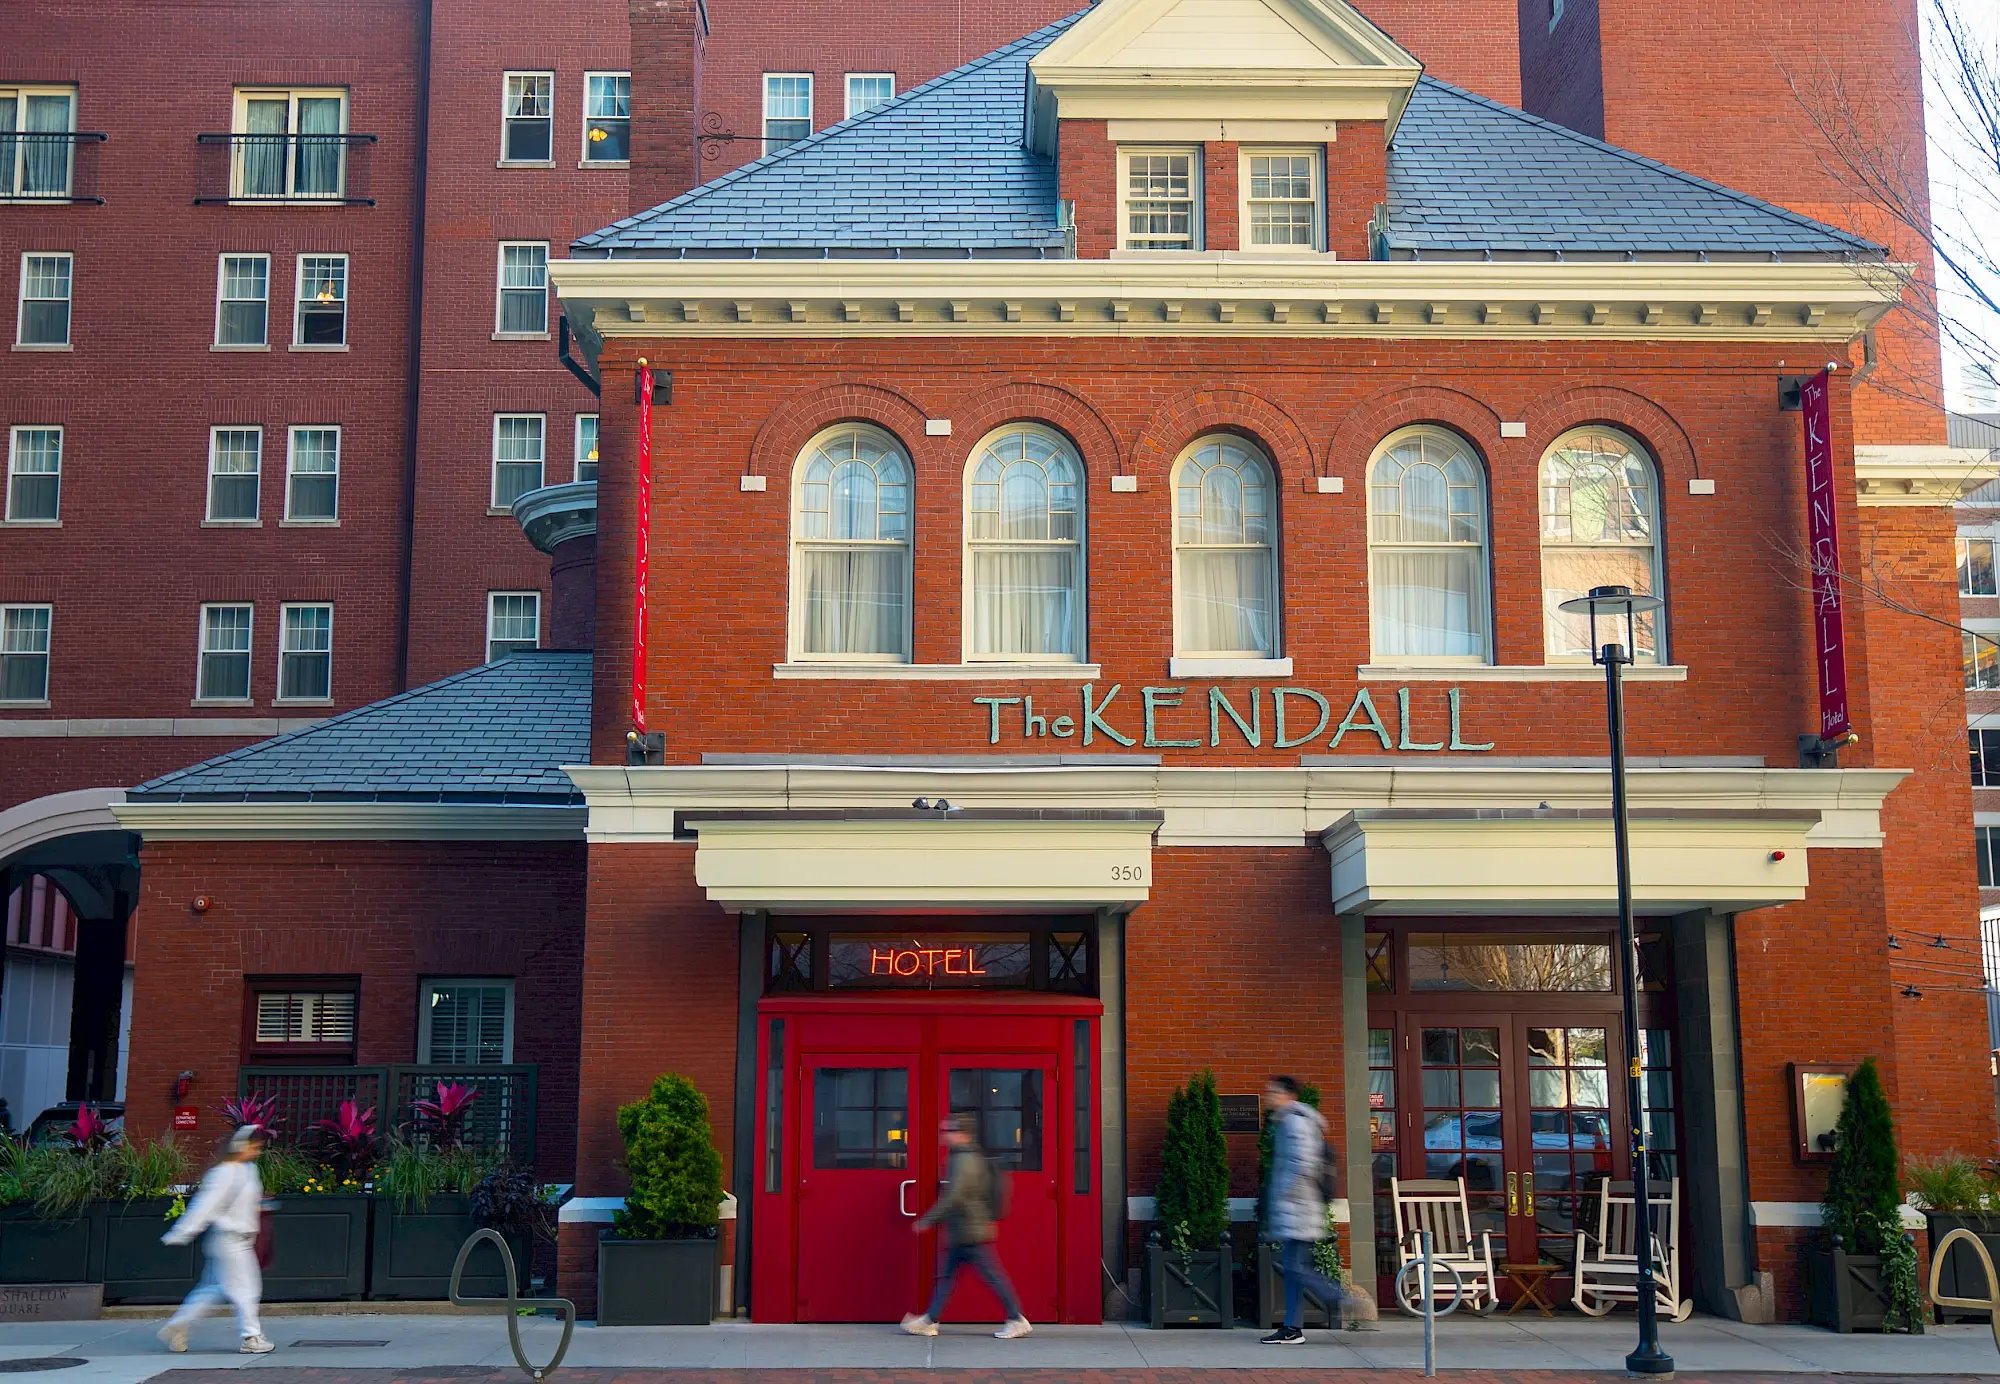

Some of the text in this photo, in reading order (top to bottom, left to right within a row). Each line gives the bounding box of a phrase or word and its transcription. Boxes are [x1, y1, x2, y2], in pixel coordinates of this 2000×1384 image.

[1804, 383, 1821, 407] The
[1807, 411, 1838, 696] KENDALL
[973, 682, 1495, 751] The KENDALL
[1821, 702, 1844, 733] Hotel
[1111, 865, 1142, 881] 350
[871, 948, 987, 976] HOTEL
[0, 1303, 41, 1315] QUARE
